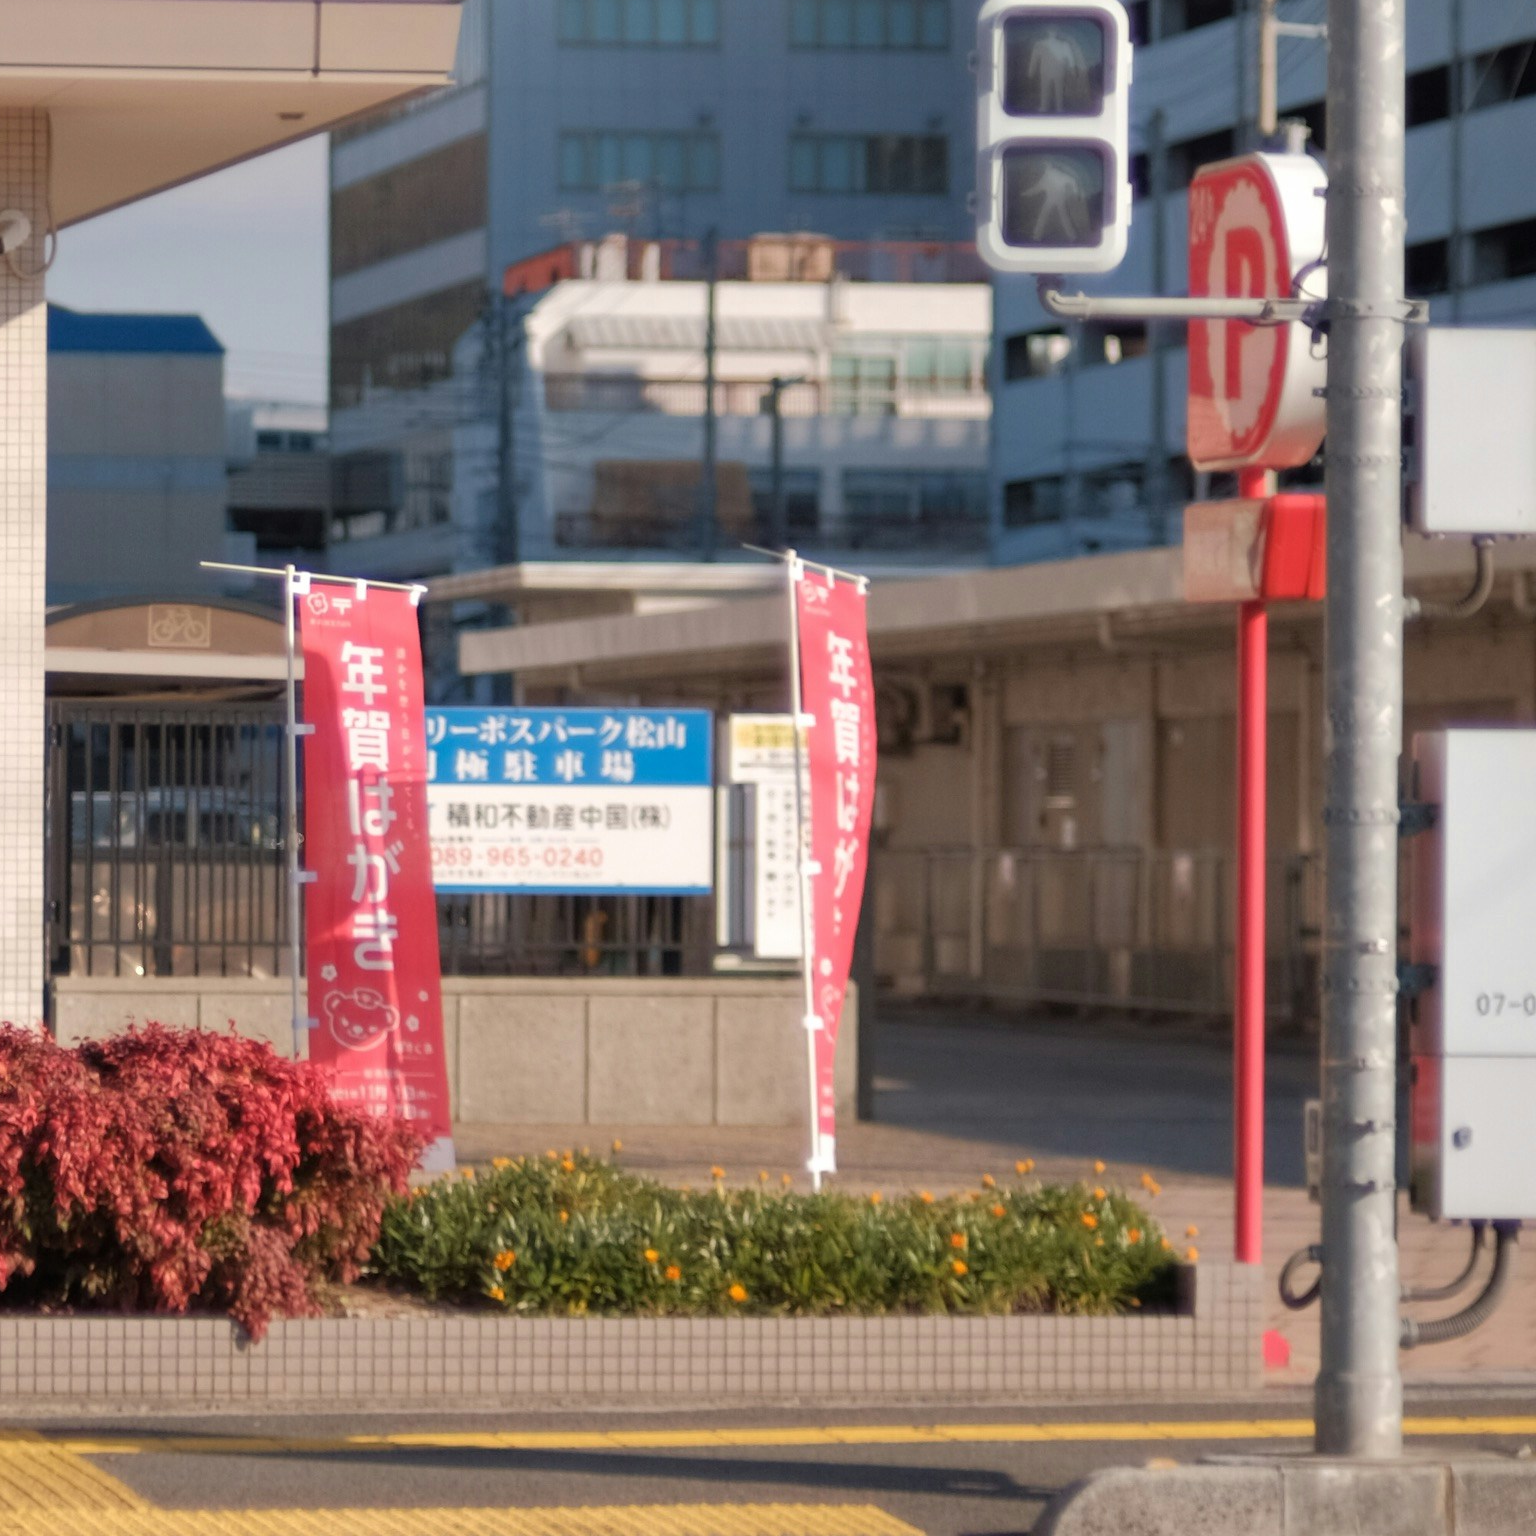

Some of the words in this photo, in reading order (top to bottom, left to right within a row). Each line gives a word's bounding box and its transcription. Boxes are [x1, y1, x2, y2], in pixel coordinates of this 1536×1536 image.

[1225, 227, 1267, 400] P
[341, 640, 404, 972] 年賀はがき
